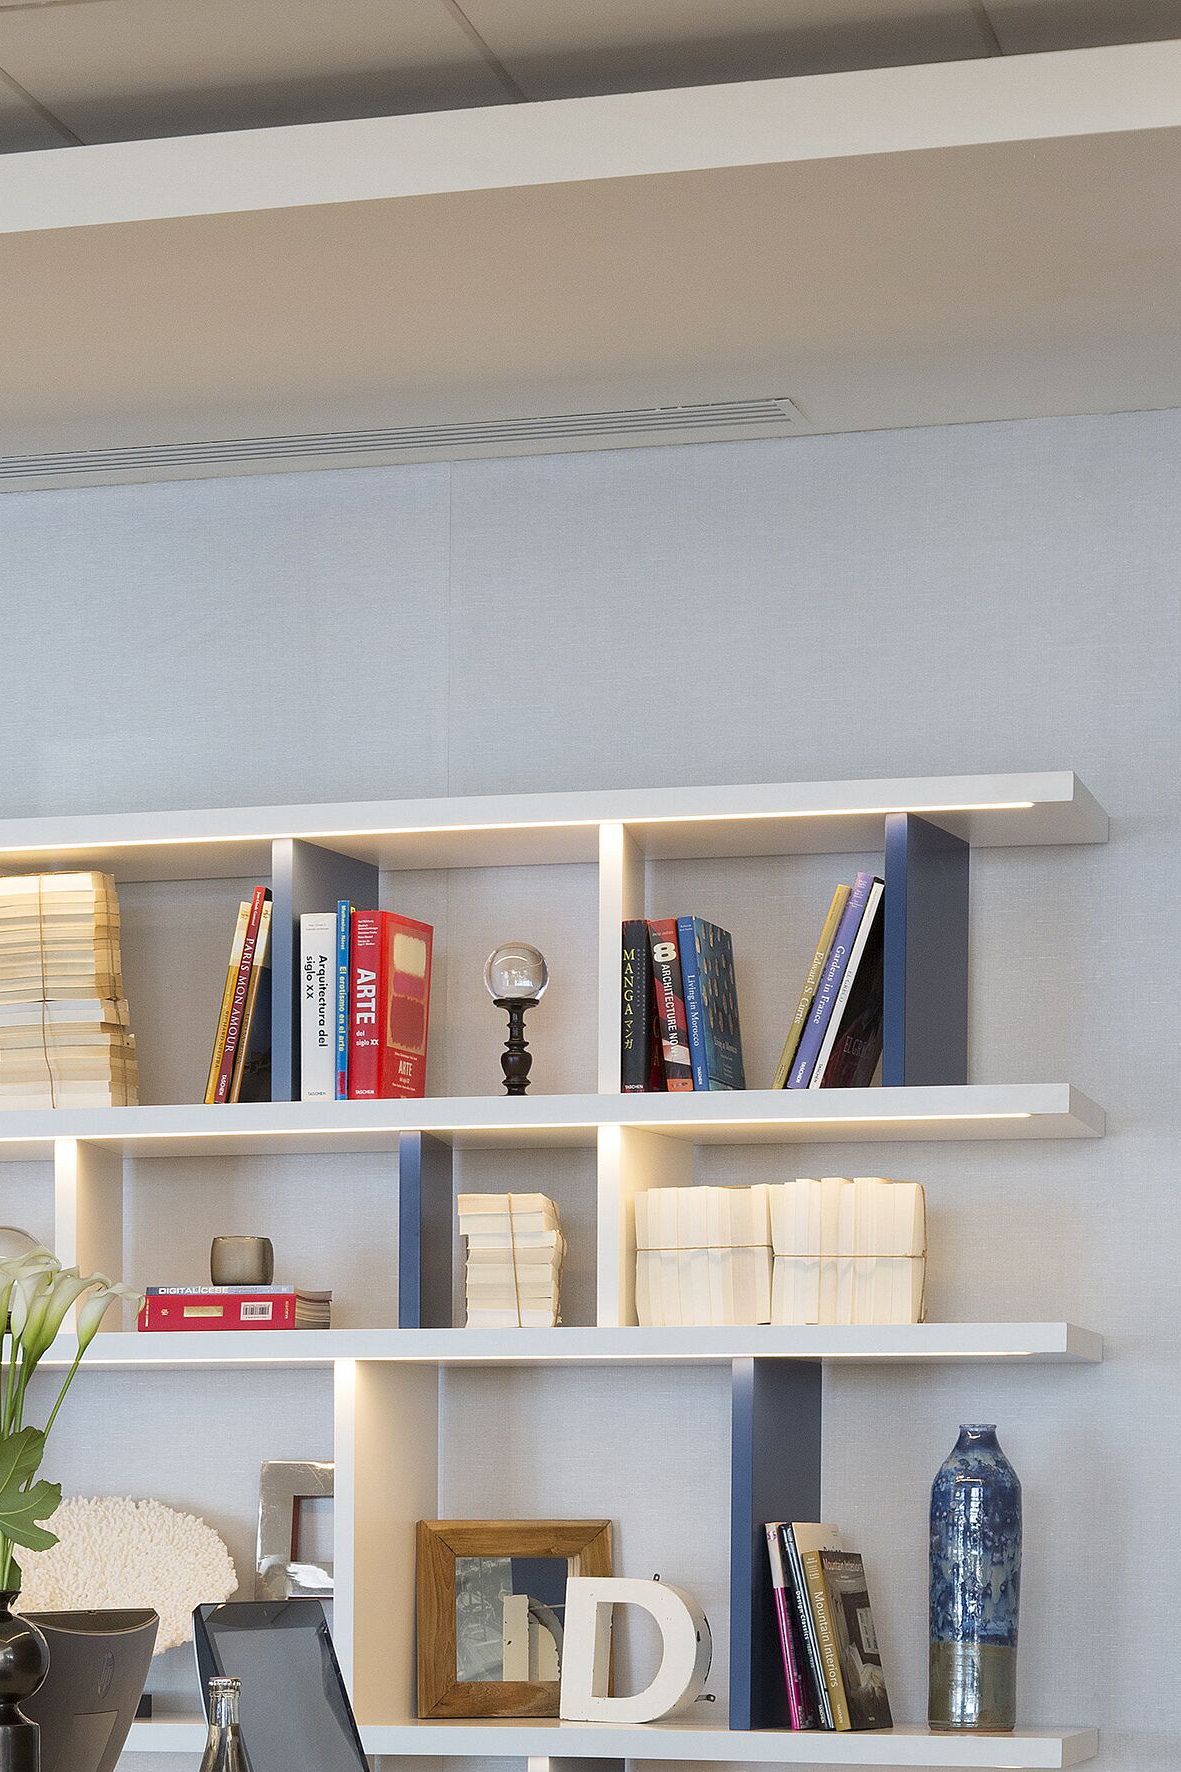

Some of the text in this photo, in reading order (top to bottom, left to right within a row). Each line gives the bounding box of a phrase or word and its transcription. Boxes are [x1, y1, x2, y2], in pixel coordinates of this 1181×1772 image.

[304, 956, 315, 981] siglo
[339, 966, 347, 974] El
[653, 942, 677, 963] 8
[225, 938, 255, 1052] PARIS MON AMOUR
[316, 955, 329, 1048] Arquitectura del
[339, 976, 347, 1012] erotismo
[356, 968, 376, 1024] ARTE
[623, 948, 635, 1015] MANGA
[661, 963, 677, 1033] ARCHITECTURE
[794, 951, 824, 1024] Edward S. Curtis
[813, 946, 846, 1024] Gardens in France
[339, 1015, 345, 1024] en
[339, 1026, 346, 1034] el
[687, 975, 700, 1047] Living in Morocco
[356, 1039, 370, 1047] siglo
[624, 1020, 634, 1050] マンガ
[398, 1060, 412, 1077] ARTE
[796, 1062, 807, 1084] TASCHEN
[795, 1591, 809, 1640] Design Classics
[813, 1591, 838, 1688] Mountain Interiors
